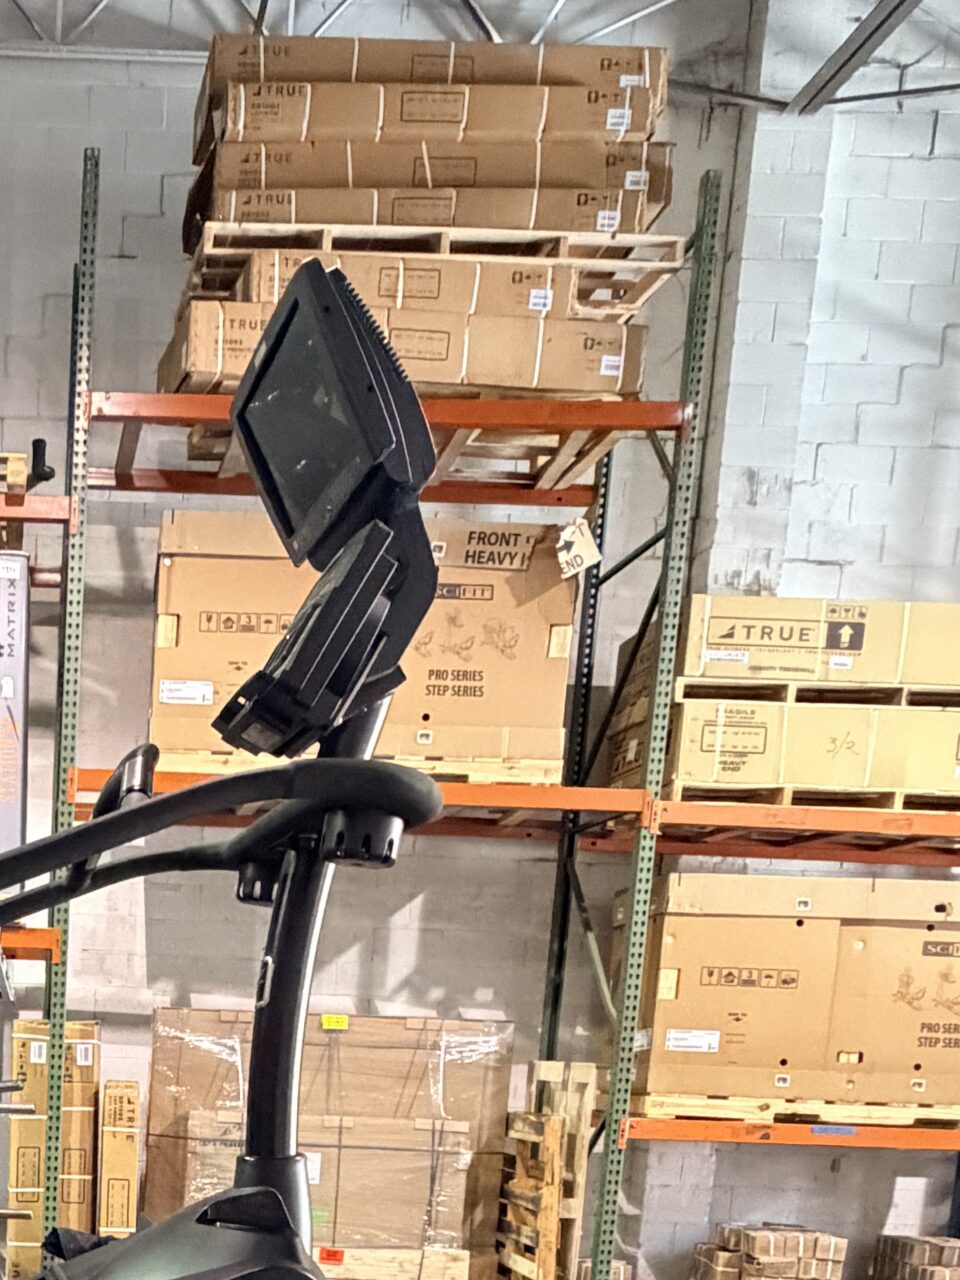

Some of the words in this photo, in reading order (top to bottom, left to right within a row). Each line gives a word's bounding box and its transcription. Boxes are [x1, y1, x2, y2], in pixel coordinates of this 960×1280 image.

[267, 85, 307, 97] TRUE
[467, 530, 522, 548] FRONT
[464, 550, 518, 567] HEAVY
[7, 578, 17, 657] MATRIX
[742, 624, 810, 642] TRUE
[428, 669, 449, 681] PRO
[450, 669, 484, 681] SERIES
[425, 685, 450, 696] STEP
[450, 685, 484, 697] SERIES
[920, 1022, 940, 1033] PRO
[917, 1036, 941, 1048] STEP
[126, 1108, 136, 1143] TRE
